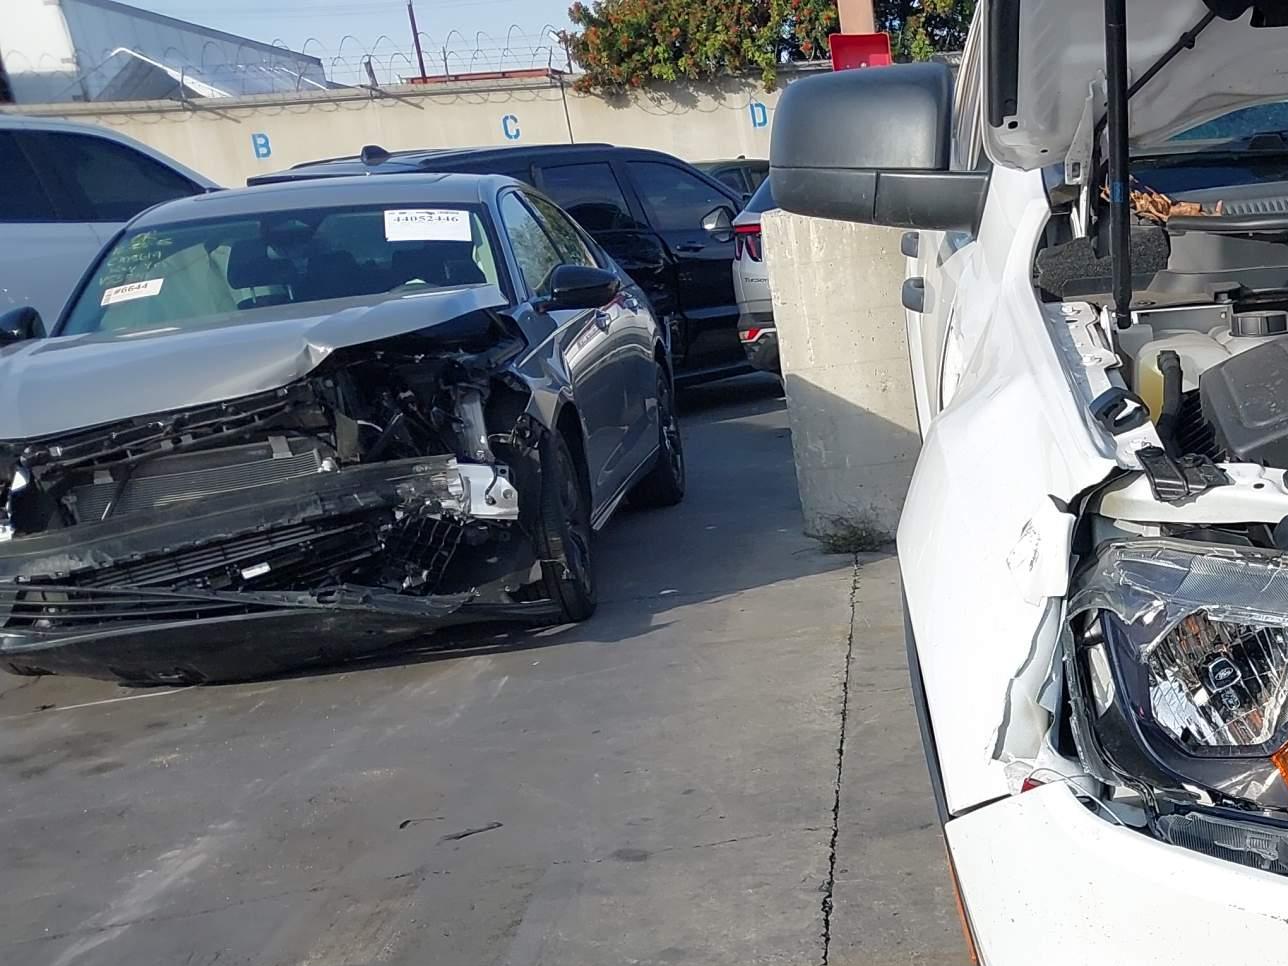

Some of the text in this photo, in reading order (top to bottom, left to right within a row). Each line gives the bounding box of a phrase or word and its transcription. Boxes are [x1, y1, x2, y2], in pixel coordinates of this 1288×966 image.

[503, 115, 520, 140] C
[750, 102, 768, 128] D
[252, 133, 271, 159] B
[393, 215, 460, 223] 44052446
